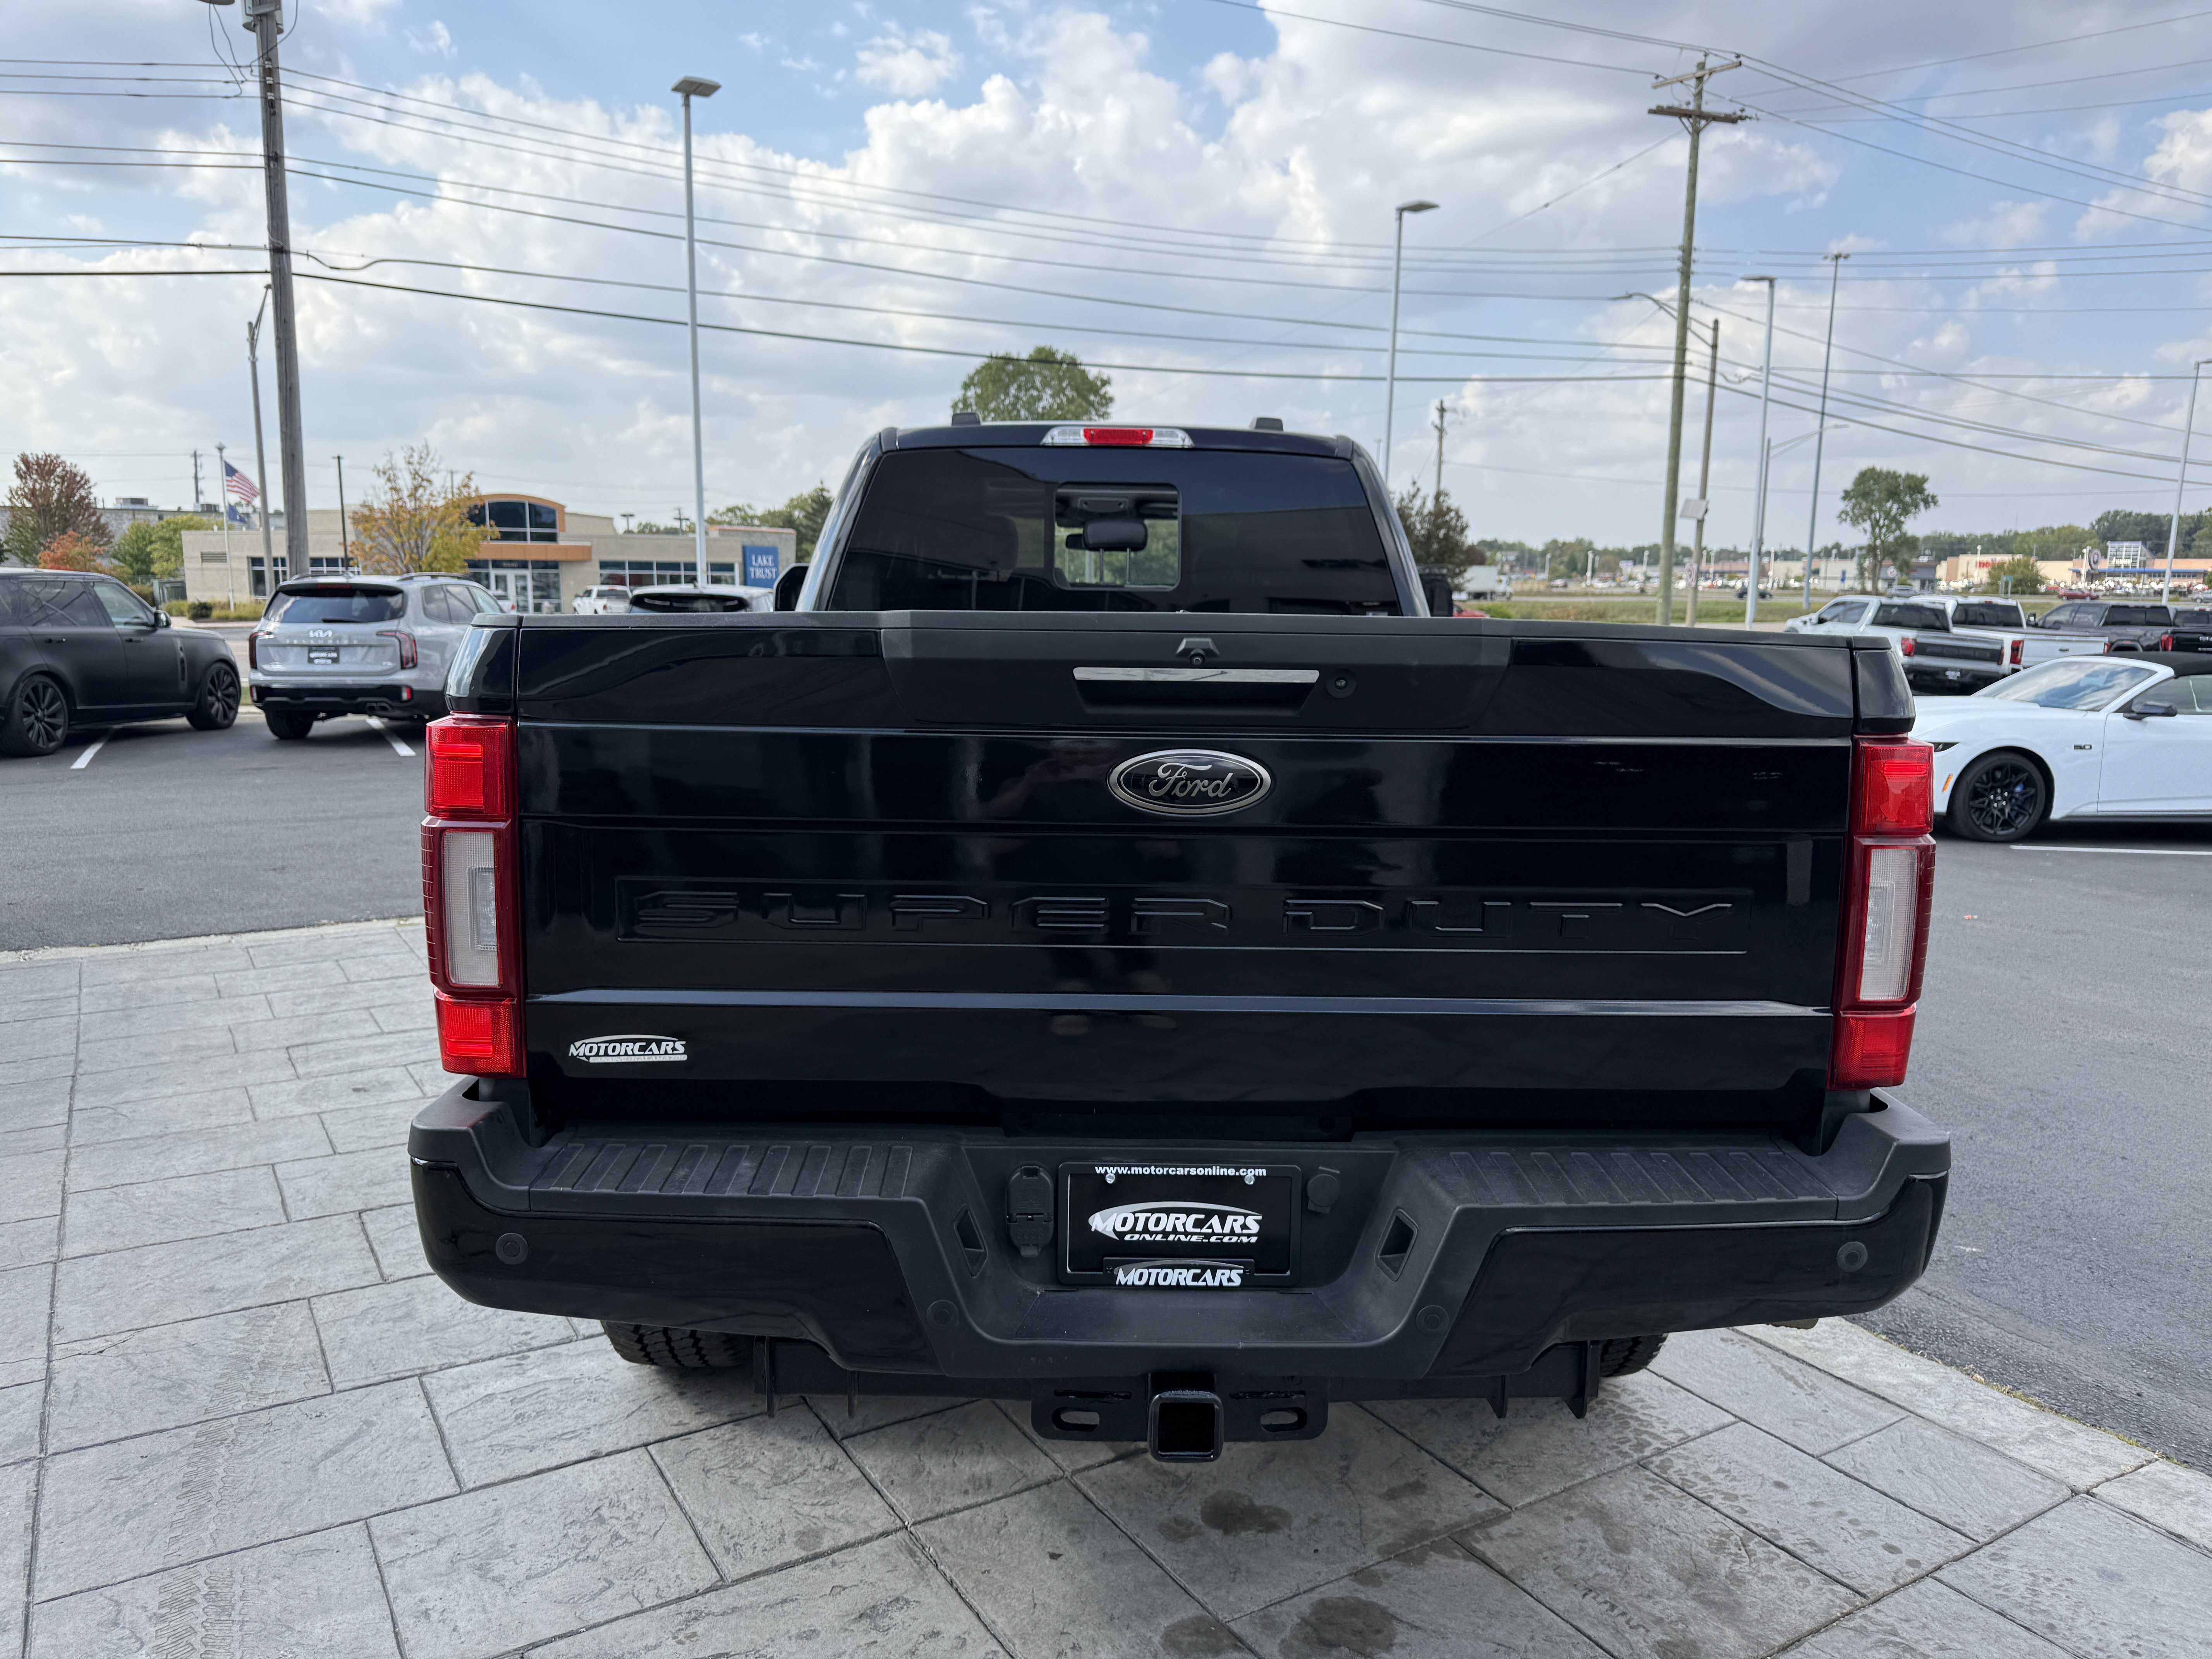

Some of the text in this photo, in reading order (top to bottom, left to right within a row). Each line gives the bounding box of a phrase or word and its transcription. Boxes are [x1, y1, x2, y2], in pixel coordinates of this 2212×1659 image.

[752, 555, 774, 566] LAKE
[750, 567, 777, 579] TRUST
[1149, 763, 1233, 797] Ford
[634, 891, 1733, 939] SUPER DUTY
[569, 1041, 686, 1056] MOTORCARS
[1095, 1166, 1266, 1176] www.motorcarsonline.com
[1091, 1213, 1262, 1233] MOTORCARS
[1124, 1234, 1258, 1243] ONLINE.COM
[1116, 1268, 1243, 1286] MOTORCARS
